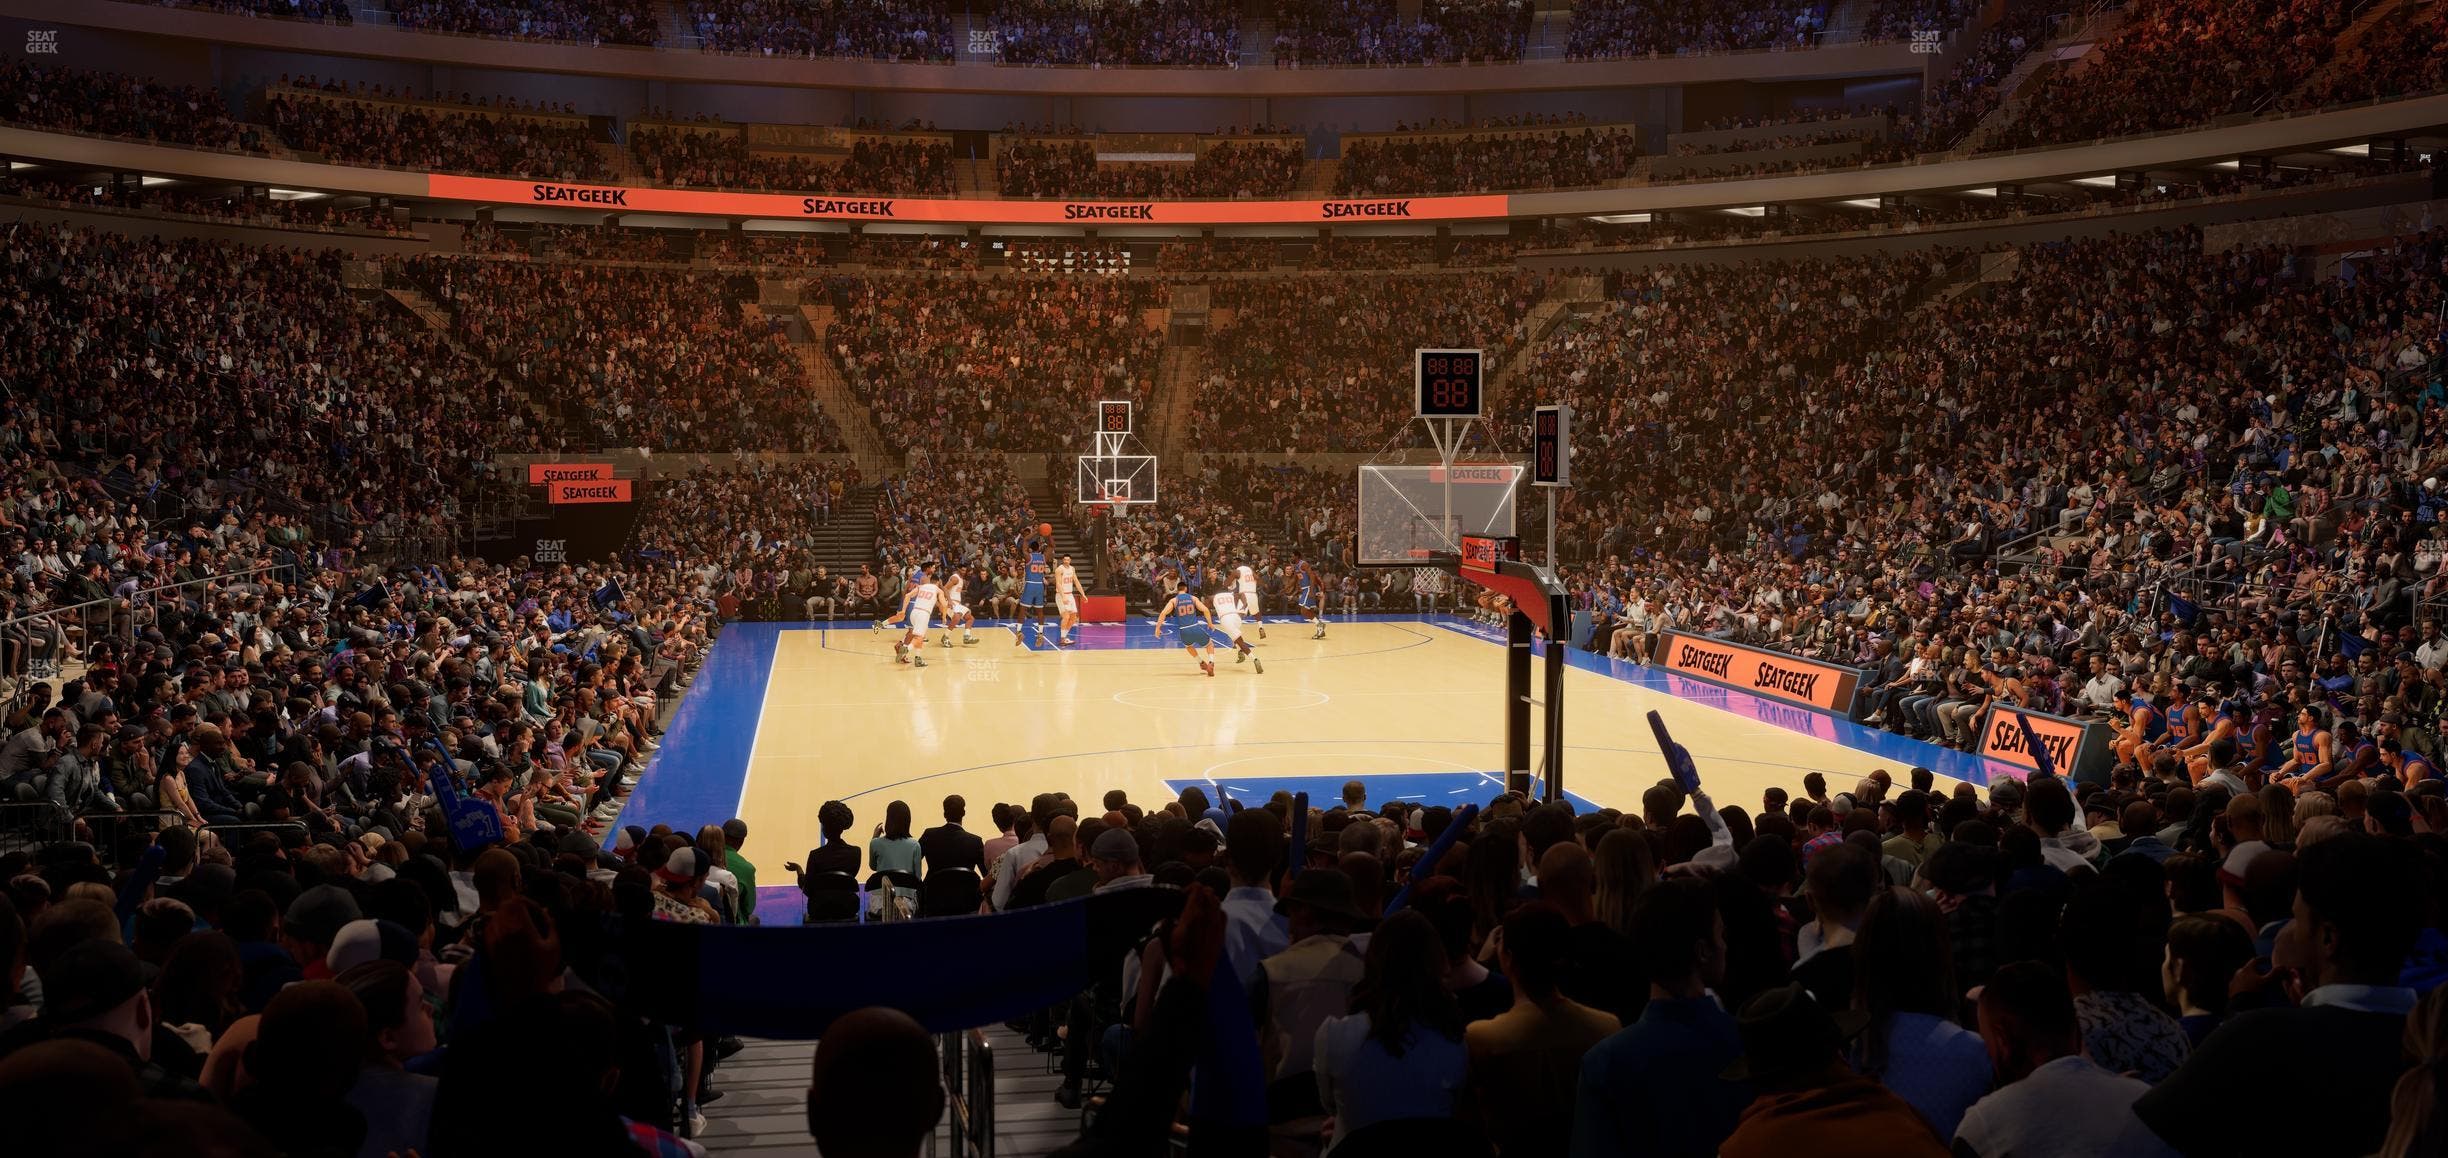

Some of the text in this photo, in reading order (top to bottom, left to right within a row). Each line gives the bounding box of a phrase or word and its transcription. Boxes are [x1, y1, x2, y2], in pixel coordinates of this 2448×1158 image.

[533, 184, 627, 206] SEATGEEK
[802, 198, 894, 217] SEATGEEK
[1064, 204, 1153, 221] SEATGEEK
[1322, 201, 1411, 219] SEATGEEK
[1433, 379, 1468, 407] 88
[1107, 415, 1124, 430] 88
[562, 485, 618, 500] SEATGEEK
[1178, 605, 1195, 617] 00
[1678, 643, 1734, 680] SEATGEEK
[1754, 661, 1820, 701] SEATGEEK
